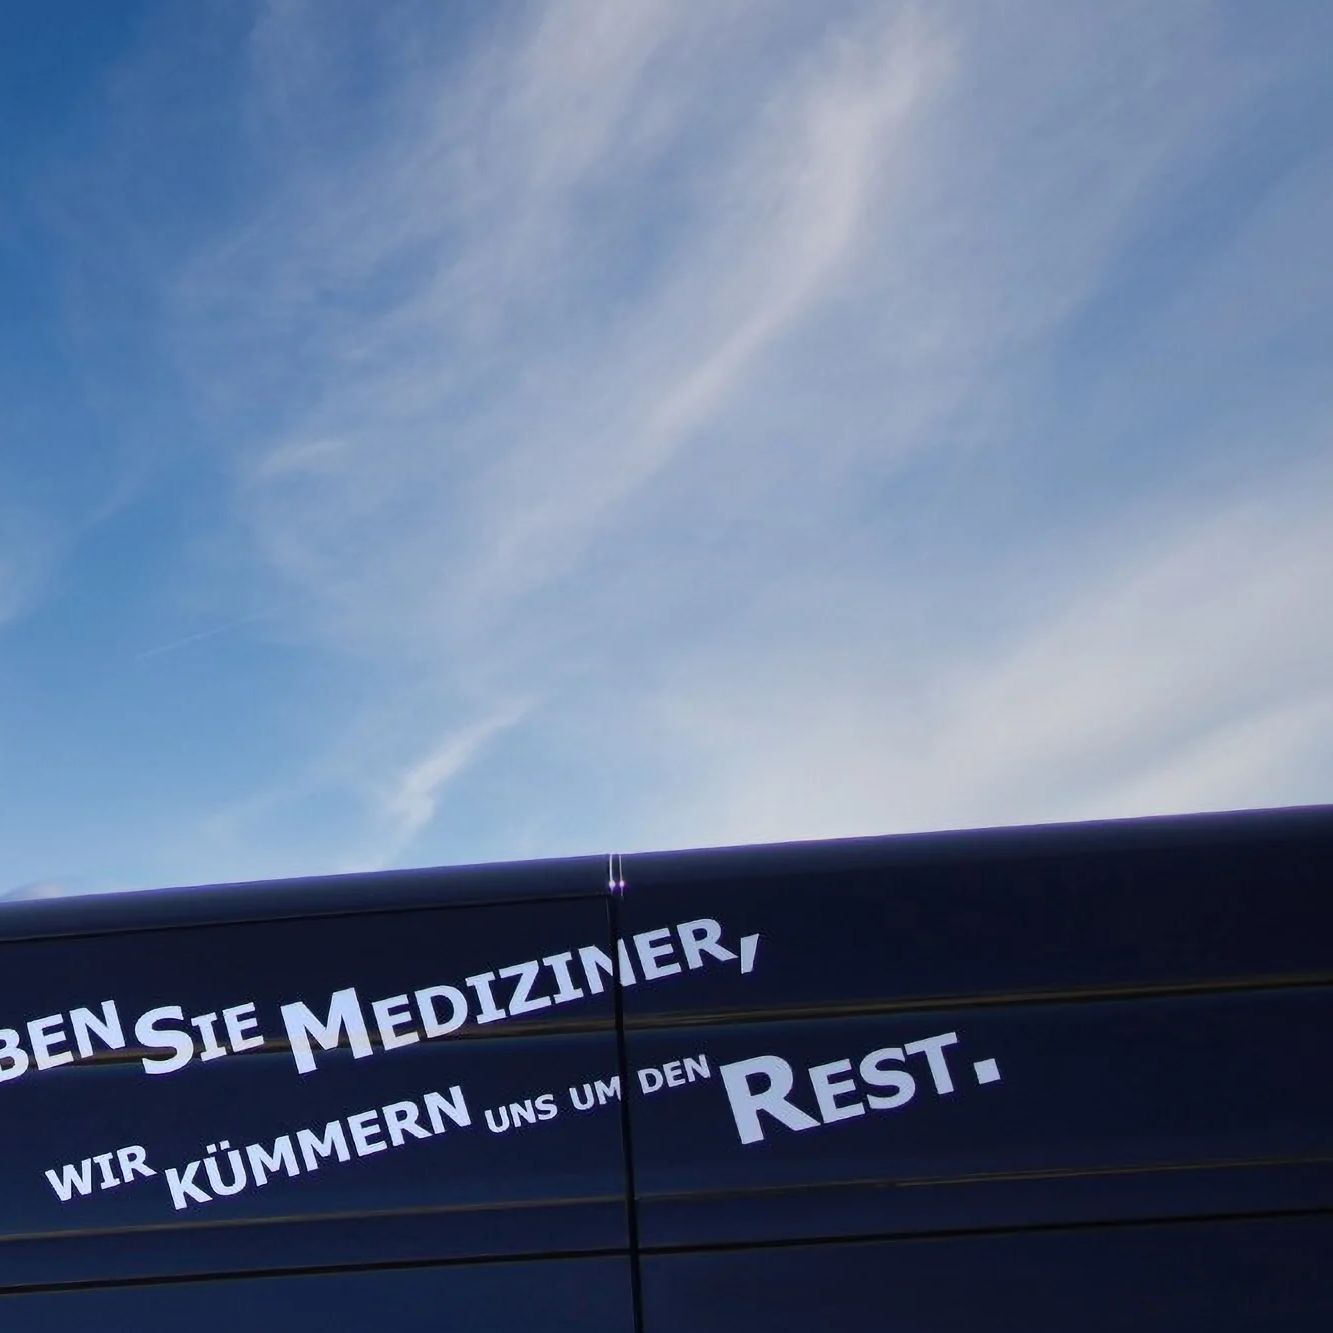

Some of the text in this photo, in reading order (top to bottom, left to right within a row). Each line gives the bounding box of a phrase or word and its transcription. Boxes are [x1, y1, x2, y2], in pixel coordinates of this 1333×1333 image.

[44, 1031, 1001, 1211] WIR KÜMMERN UNS UM DEN REST.
